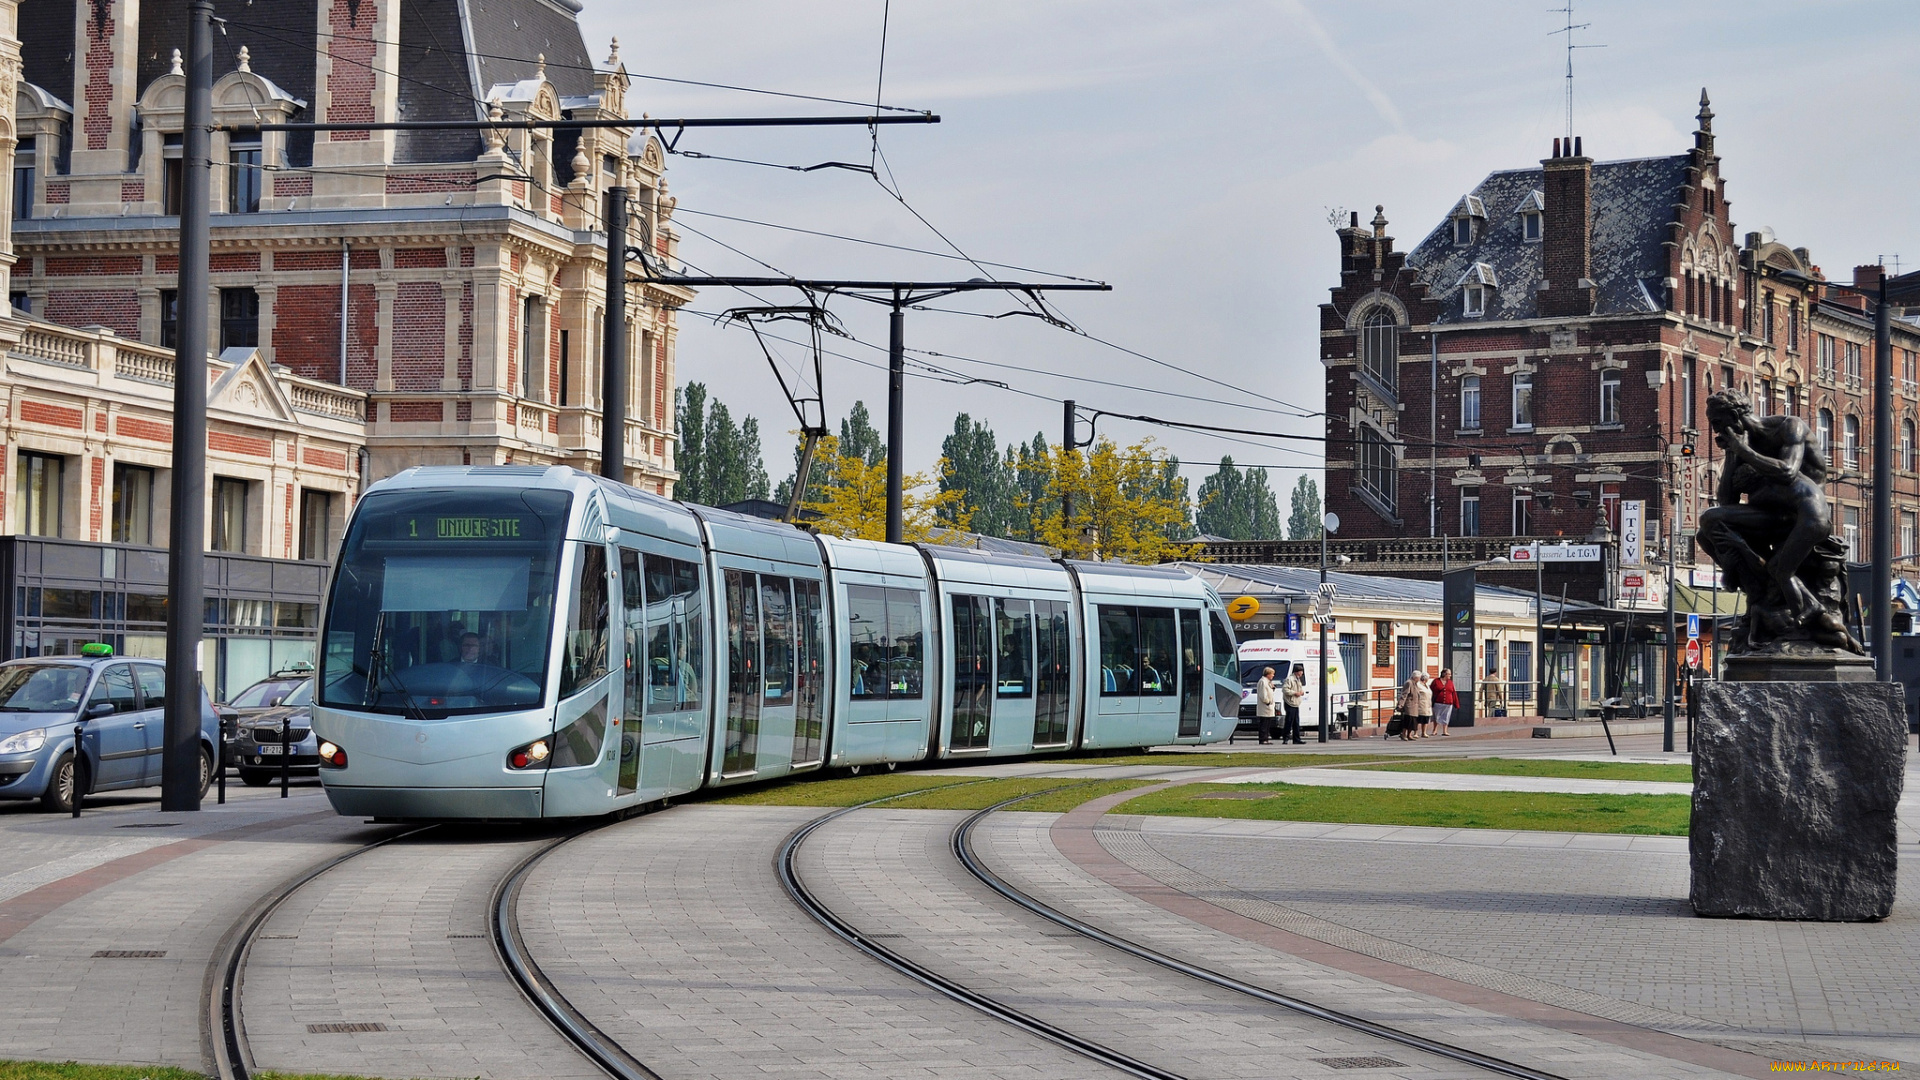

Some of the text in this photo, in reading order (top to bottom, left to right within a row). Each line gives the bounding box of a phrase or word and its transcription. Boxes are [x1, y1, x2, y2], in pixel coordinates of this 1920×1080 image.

[1683, 457, 1693, 522] MAMOUNIA
[1625, 501, 1638, 511] Le
[409, 518, 520, 537] 1 UNIVERSITE
[1566, 548, 1576, 558] Le
